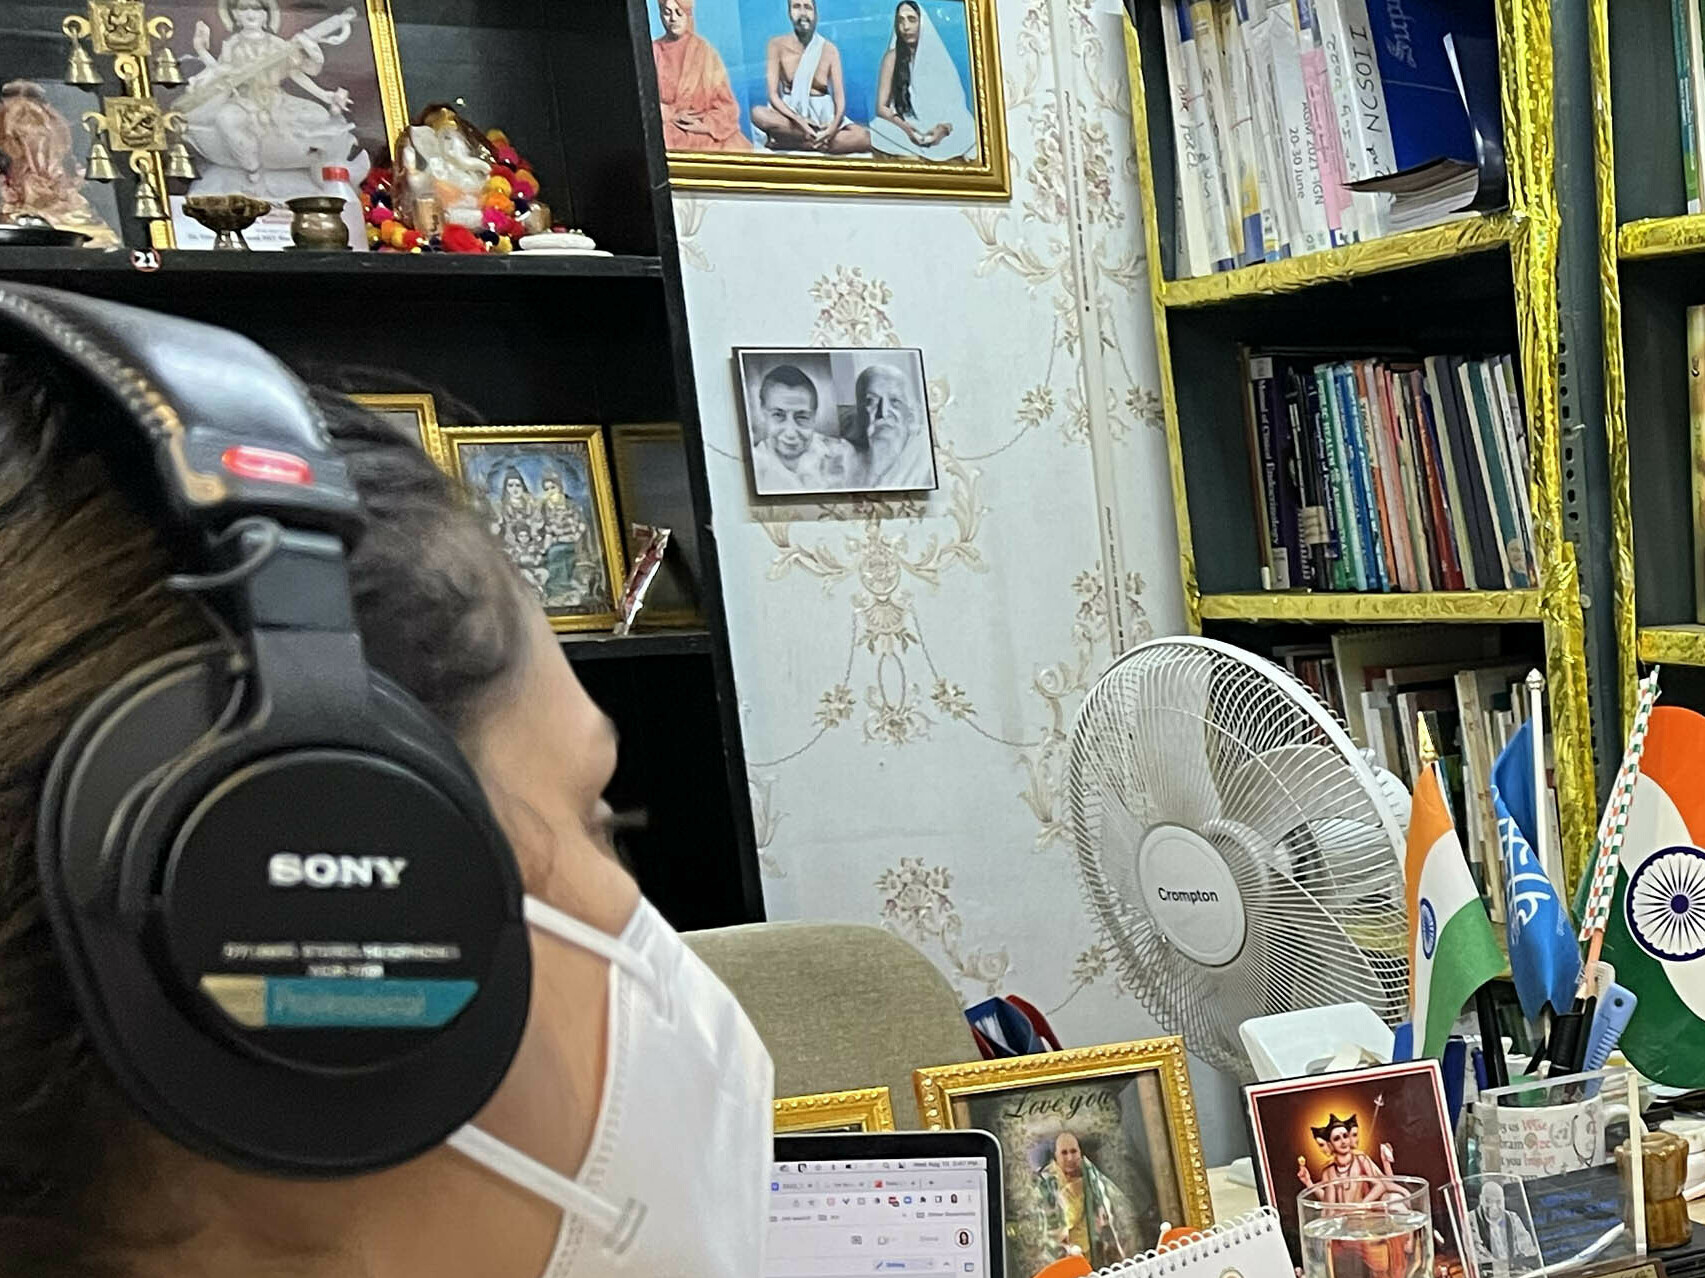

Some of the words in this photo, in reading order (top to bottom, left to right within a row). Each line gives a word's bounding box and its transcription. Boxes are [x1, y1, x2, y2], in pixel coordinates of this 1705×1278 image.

[1294, 170, 1307, 199] June
[134, 253, 157, 268] 21
[1324, 421, 1336, 467] HEALTH
[1266, 462, 1279, 545] Endocrinology
[268, 853, 408, 888] SONY
[1158, 887, 1219, 905] Crompton
[1002, 1091, 1063, 1119] Love
[1066, 1090, 1109, 1120] you
